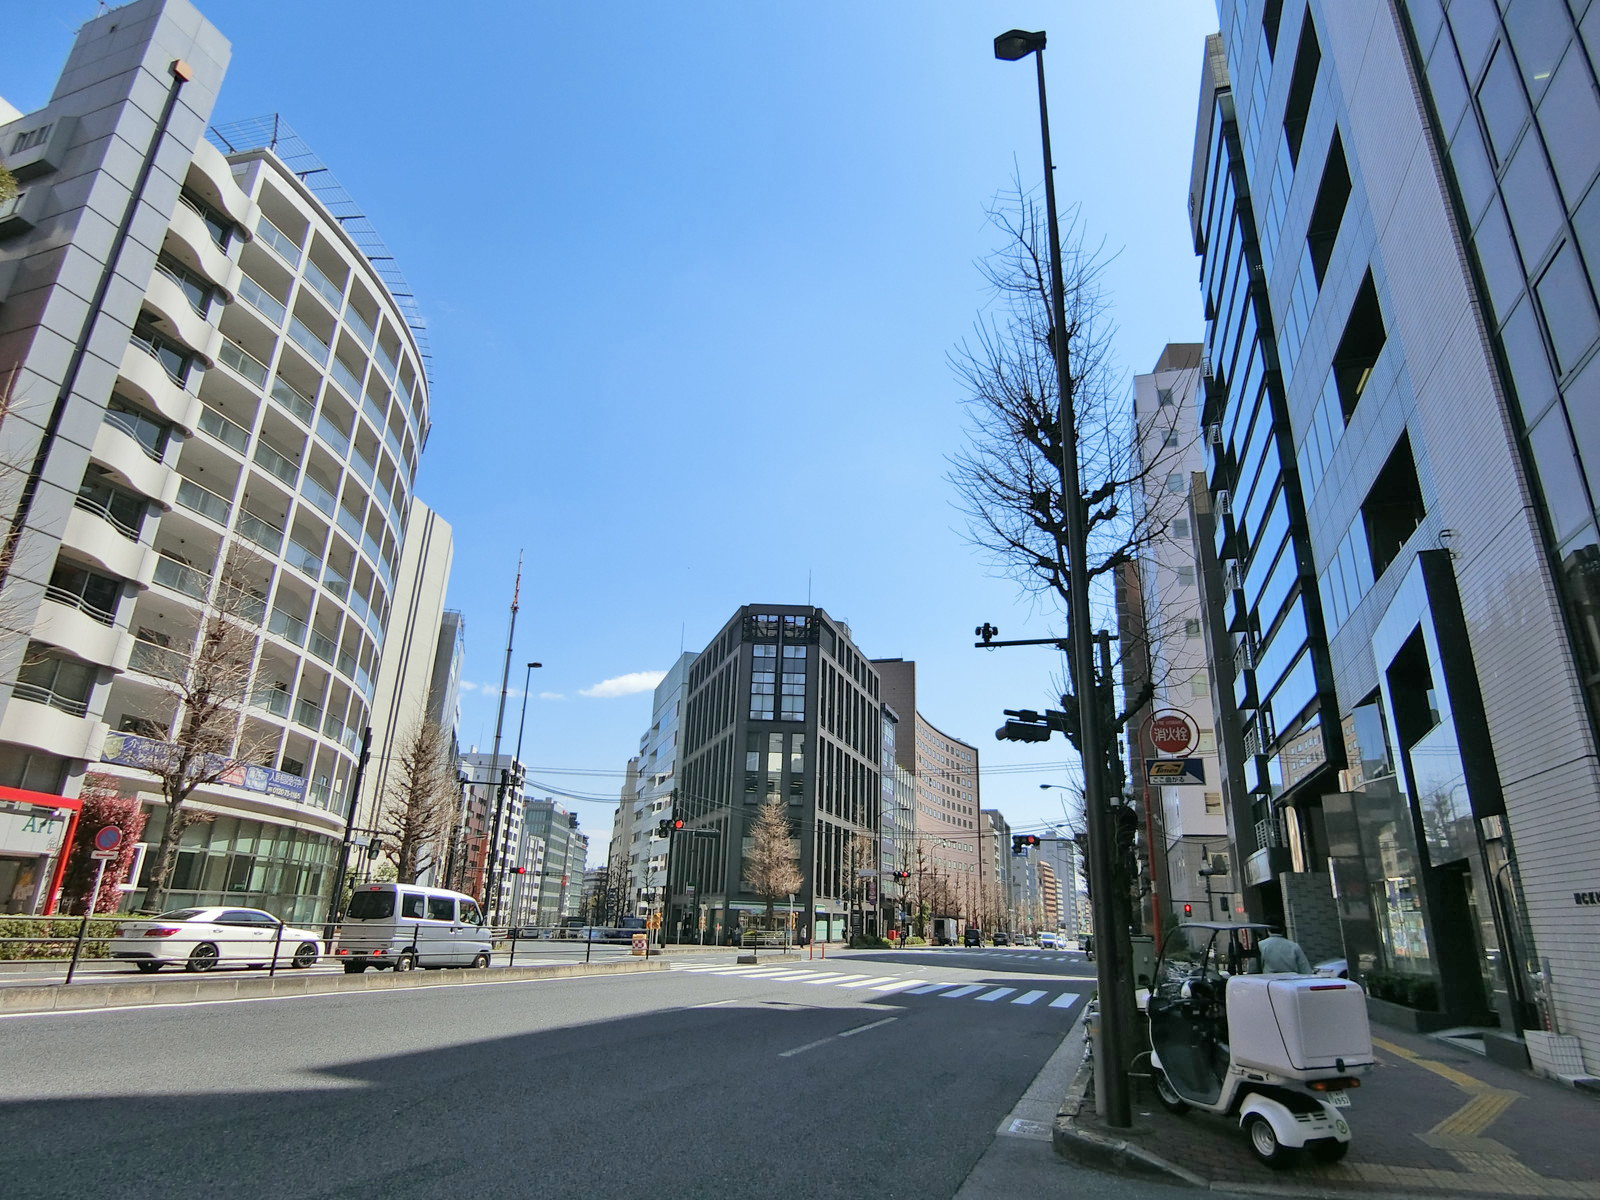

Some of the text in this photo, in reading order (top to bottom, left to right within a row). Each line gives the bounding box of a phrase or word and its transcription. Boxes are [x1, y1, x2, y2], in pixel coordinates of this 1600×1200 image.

[1154, 726, 1188, 742] 消火栓
[21, 815, 56, 834] Art
